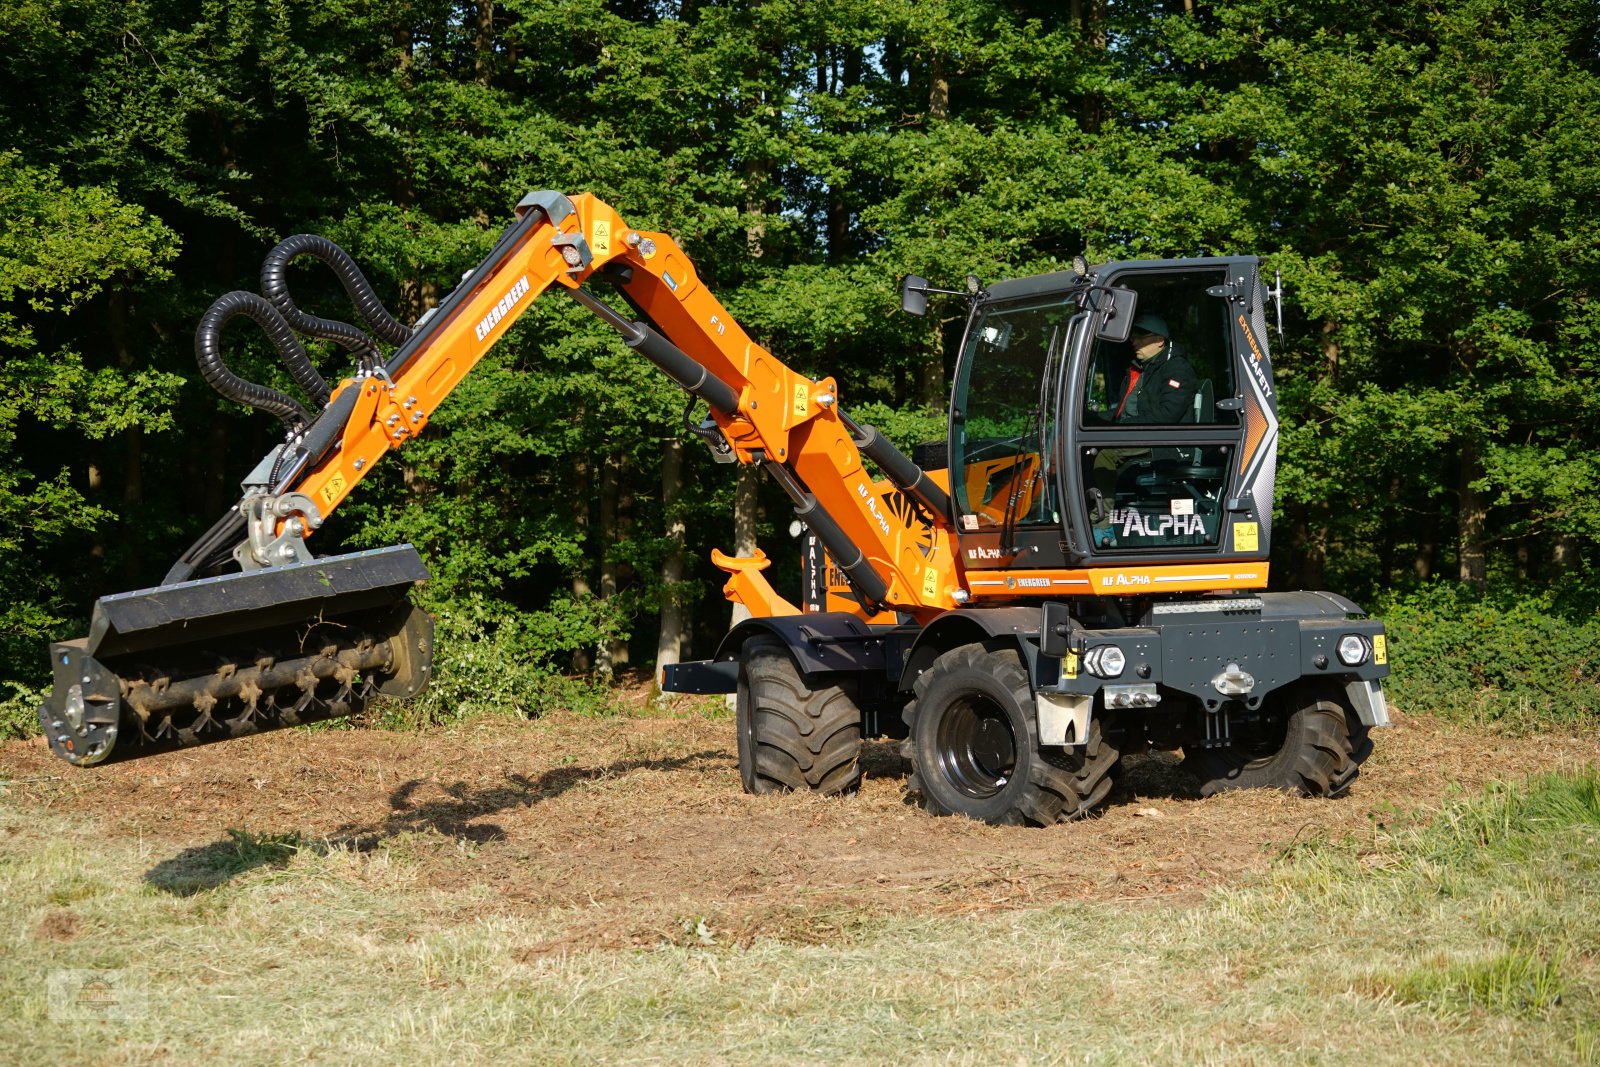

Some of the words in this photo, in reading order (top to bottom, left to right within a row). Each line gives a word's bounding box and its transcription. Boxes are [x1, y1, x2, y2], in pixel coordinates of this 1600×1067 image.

[475, 274, 530, 342] ENERGREEN
[710, 315, 719, 325] F
[717, 322, 725, 336] 11
[1238, 314, 1263, 362] EXTREME
[1249, 353, 1273, 398] SAFETY
[857, 483, 869, 498] ILF
[866, 496, 890, 536] ALPHA
[1122, 507, 1206, 537] ALPHA
[977, 546, 1003, 559] ALPHA
[1017, 578, 1051, 587] ENERGREEN
[1102, 577, 1114, 587] ILF
[1116, 574, 1151, 586] ALPHA
